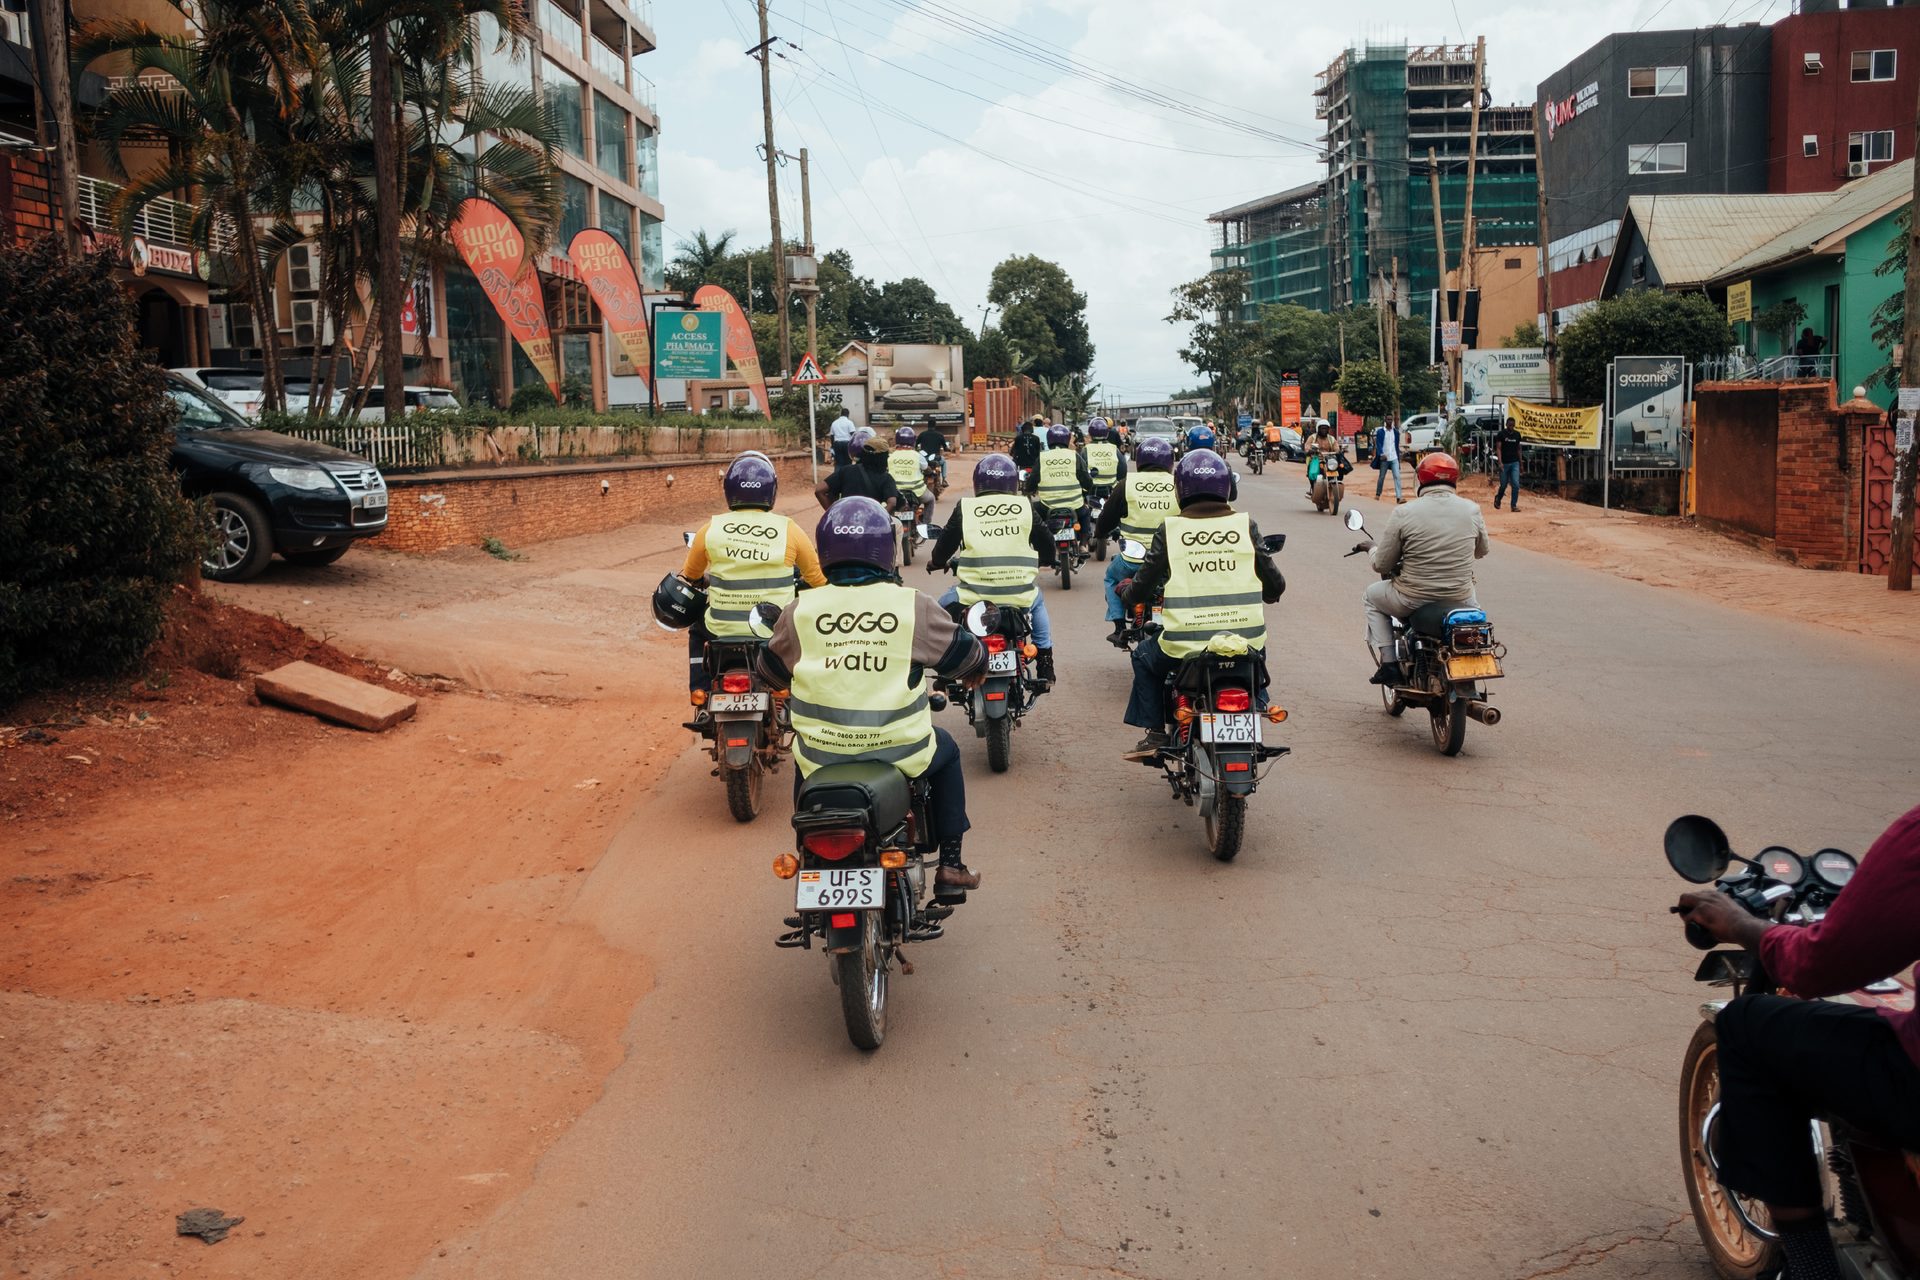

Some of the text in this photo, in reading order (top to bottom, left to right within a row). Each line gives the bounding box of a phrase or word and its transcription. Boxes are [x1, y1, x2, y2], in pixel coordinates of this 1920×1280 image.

[150, 247, 191, 272] BUDZ
[671, 332, 708, 341] ACCESS
[665, 341, 715, 351] PHARMACY
[1619, 374, 1668, 387] gazania
[1045, 458, 1071, 466] GOGO
[987, 469, 1005, 477] GOGO
[1193, 467, 1216, 475] GOGO
[740, 481, 761, 489] GOGO
[1135, 482, 1175, 493] GOGO
[974, 503, 1022, 518] GOGO
[1138, 500, 1170, 510] watu
[723, 522, 778, 540] GOGO
[834, 525, 865, 535] GOGO
[980, 525, 1020, 537] watu
[1181, 530, 1240, 546] GOGO
[726, 546, 770, 562] watu
[1188, 558, 1236, 573] watu
[816, 611, 899, 635] GOGO
[833, 639, 871, 648] partnership
[872, 639, 888, 647] with
[825, 651, 888, 672] watu
[990, 652, 1009, 661] FX
[1218, 661, 1236, 669] TVS
[733, 694, 759, 703] UFX
[1223, 714, 1253, 727] UFX
[830, 870, 871, 886] UFS
[818, 888, 873, 906] 699S
